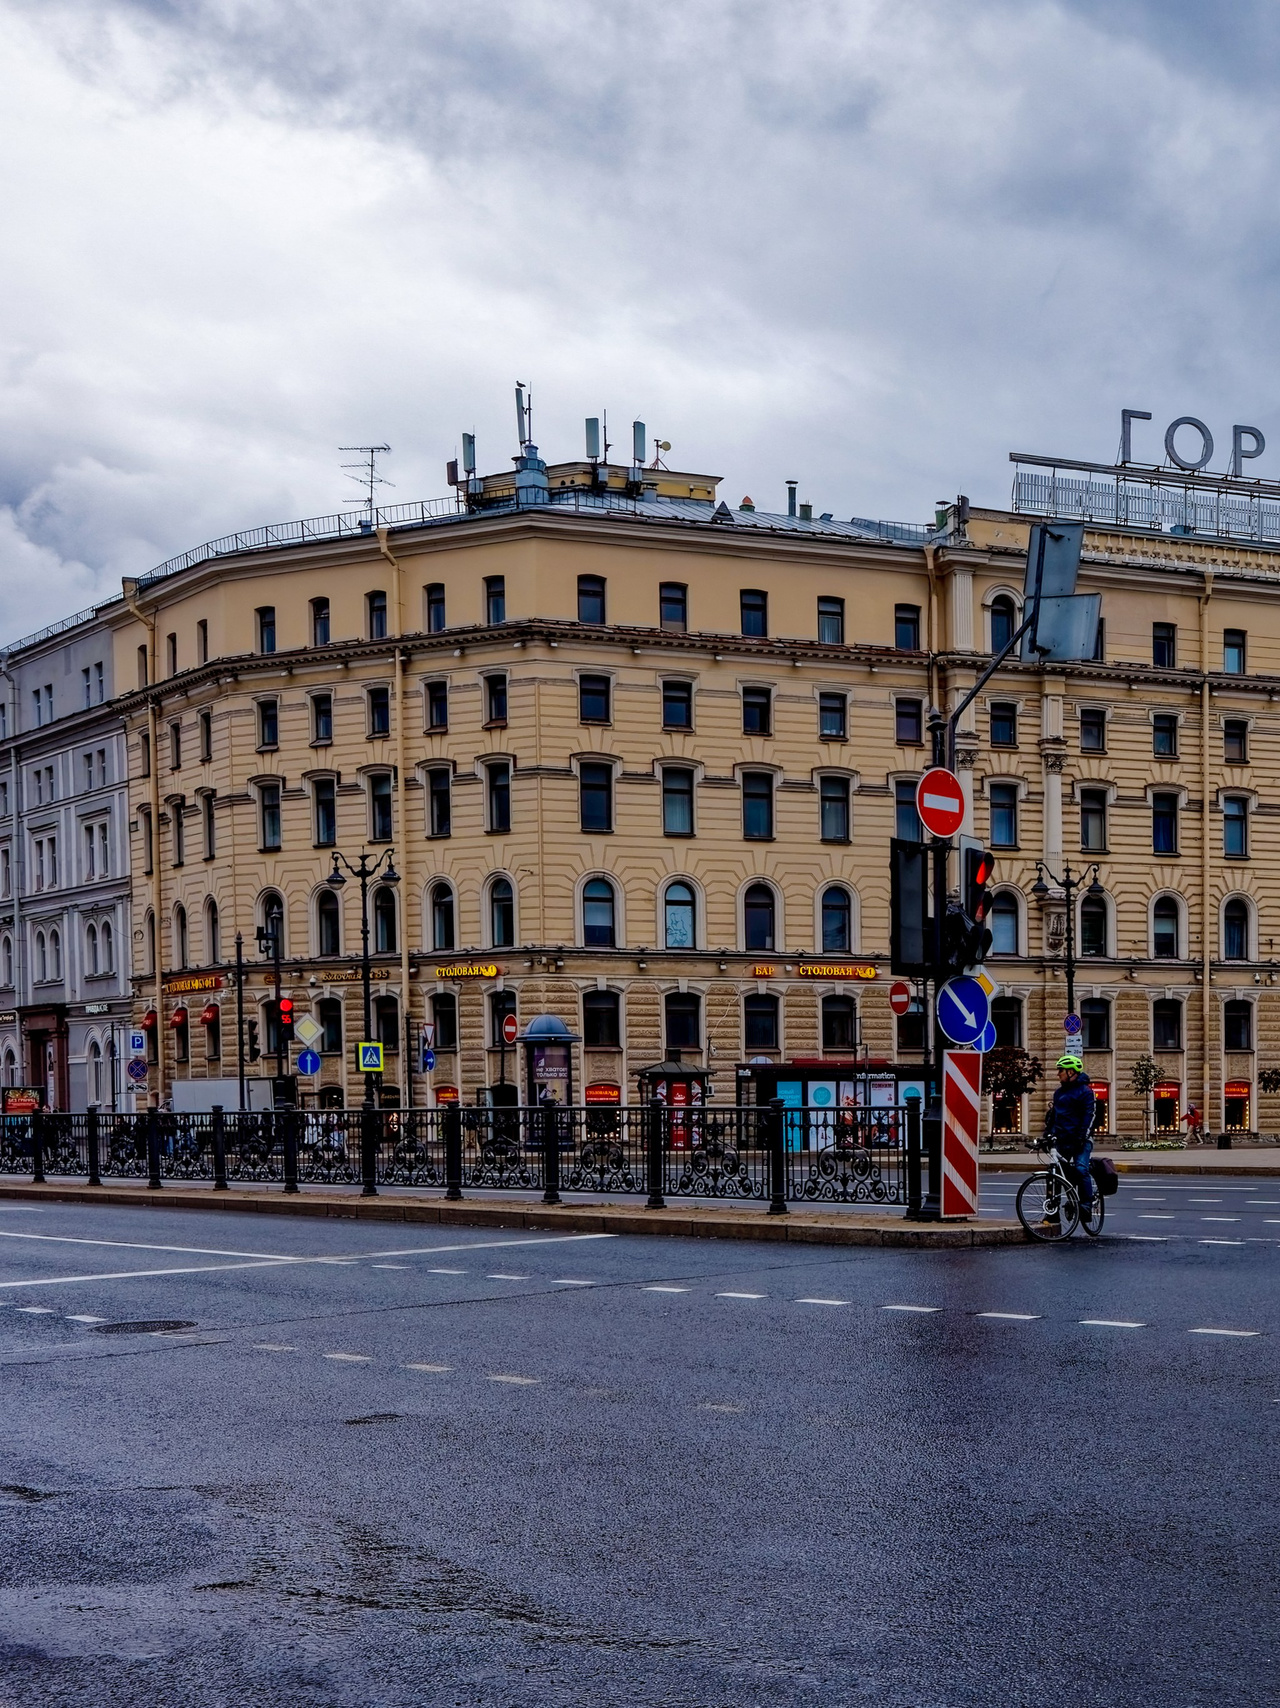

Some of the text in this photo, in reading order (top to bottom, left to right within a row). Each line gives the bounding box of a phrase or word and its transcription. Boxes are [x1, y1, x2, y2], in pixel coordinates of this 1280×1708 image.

[436, 966, 479, 977] СТОЛОВАЯ
[755, 966, 775, 975] БАР
[799, 966, 853, 976] СТОЛОВАЯ
